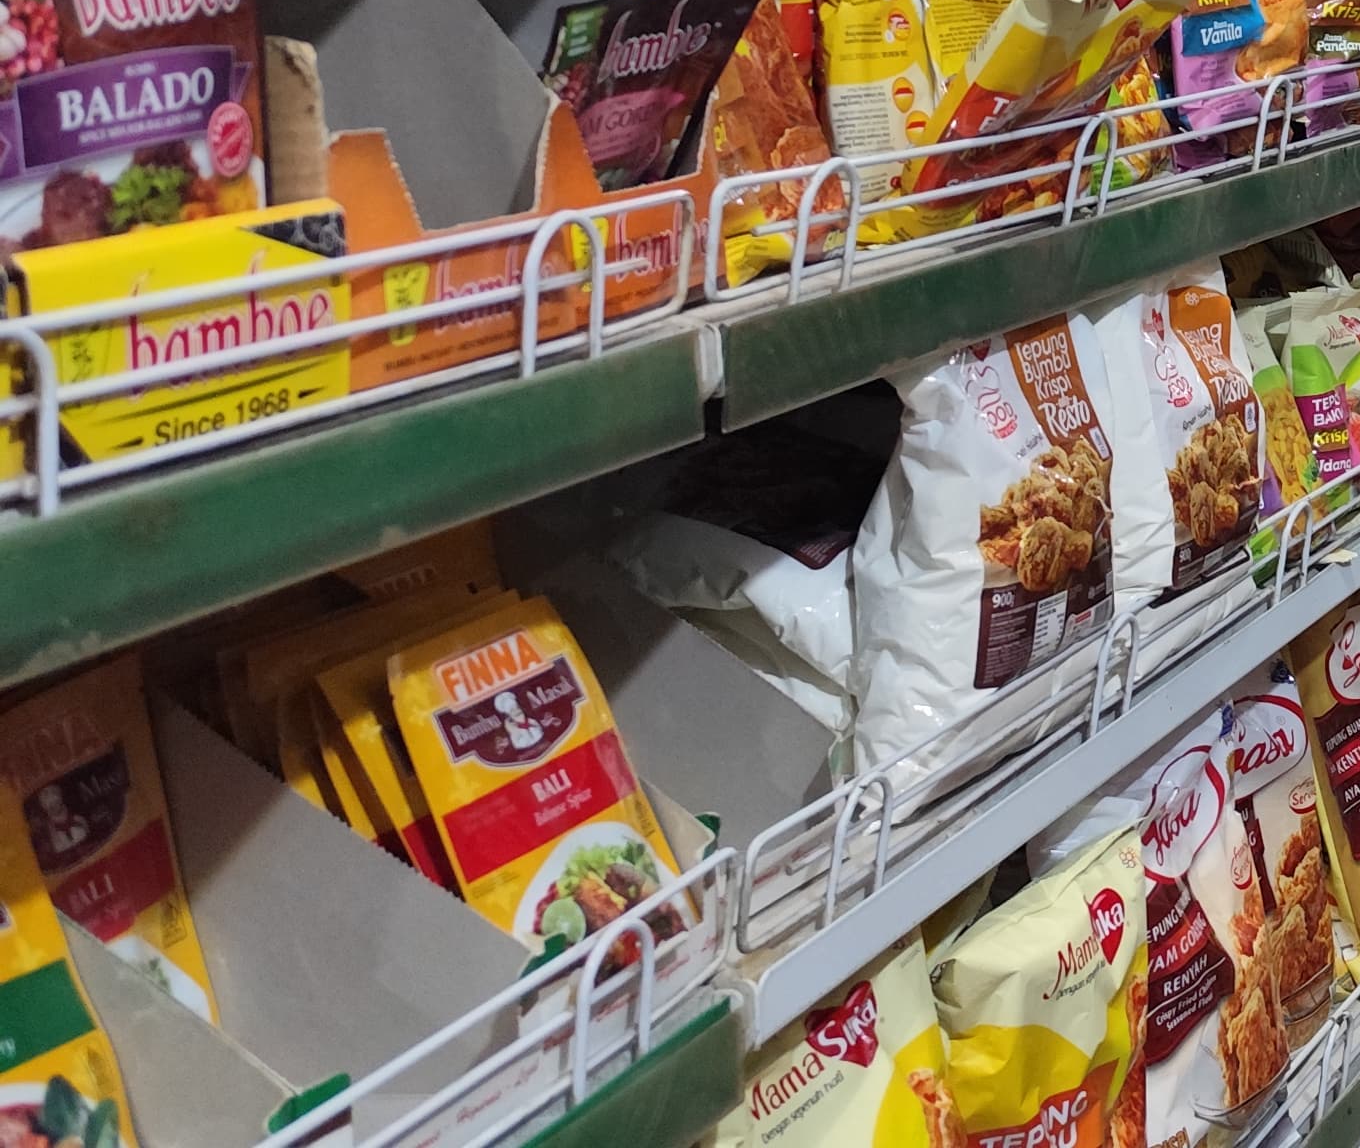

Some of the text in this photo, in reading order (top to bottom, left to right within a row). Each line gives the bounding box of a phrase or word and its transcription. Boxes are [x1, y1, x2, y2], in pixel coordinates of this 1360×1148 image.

[1200, 22, 1243, 47] Vanila
[58, 68, 215, 131] BALADO
[125, 252, 334, 396] bamboe
[1014, 331, 1069, 363] Tepung
[1021, 352, 1072, 385] Bumbu
[1034, 370, 1073, 401] Krispi
[1208, 374, 1249, 409] Resto
[153, 388, 291, 449] Since 1968
[1037, 395, 1091, 438] Resto
[1313, 428, 1349, 446] Krisp
[439, 631, 544, 702] FINNA
[530, 768, 574, 803] BALI
[1147, 907, 1182, 945] EPUNG
[1163, 953, 1209, 997] RENYAH
[814, 993, 880, 1057] Suka
